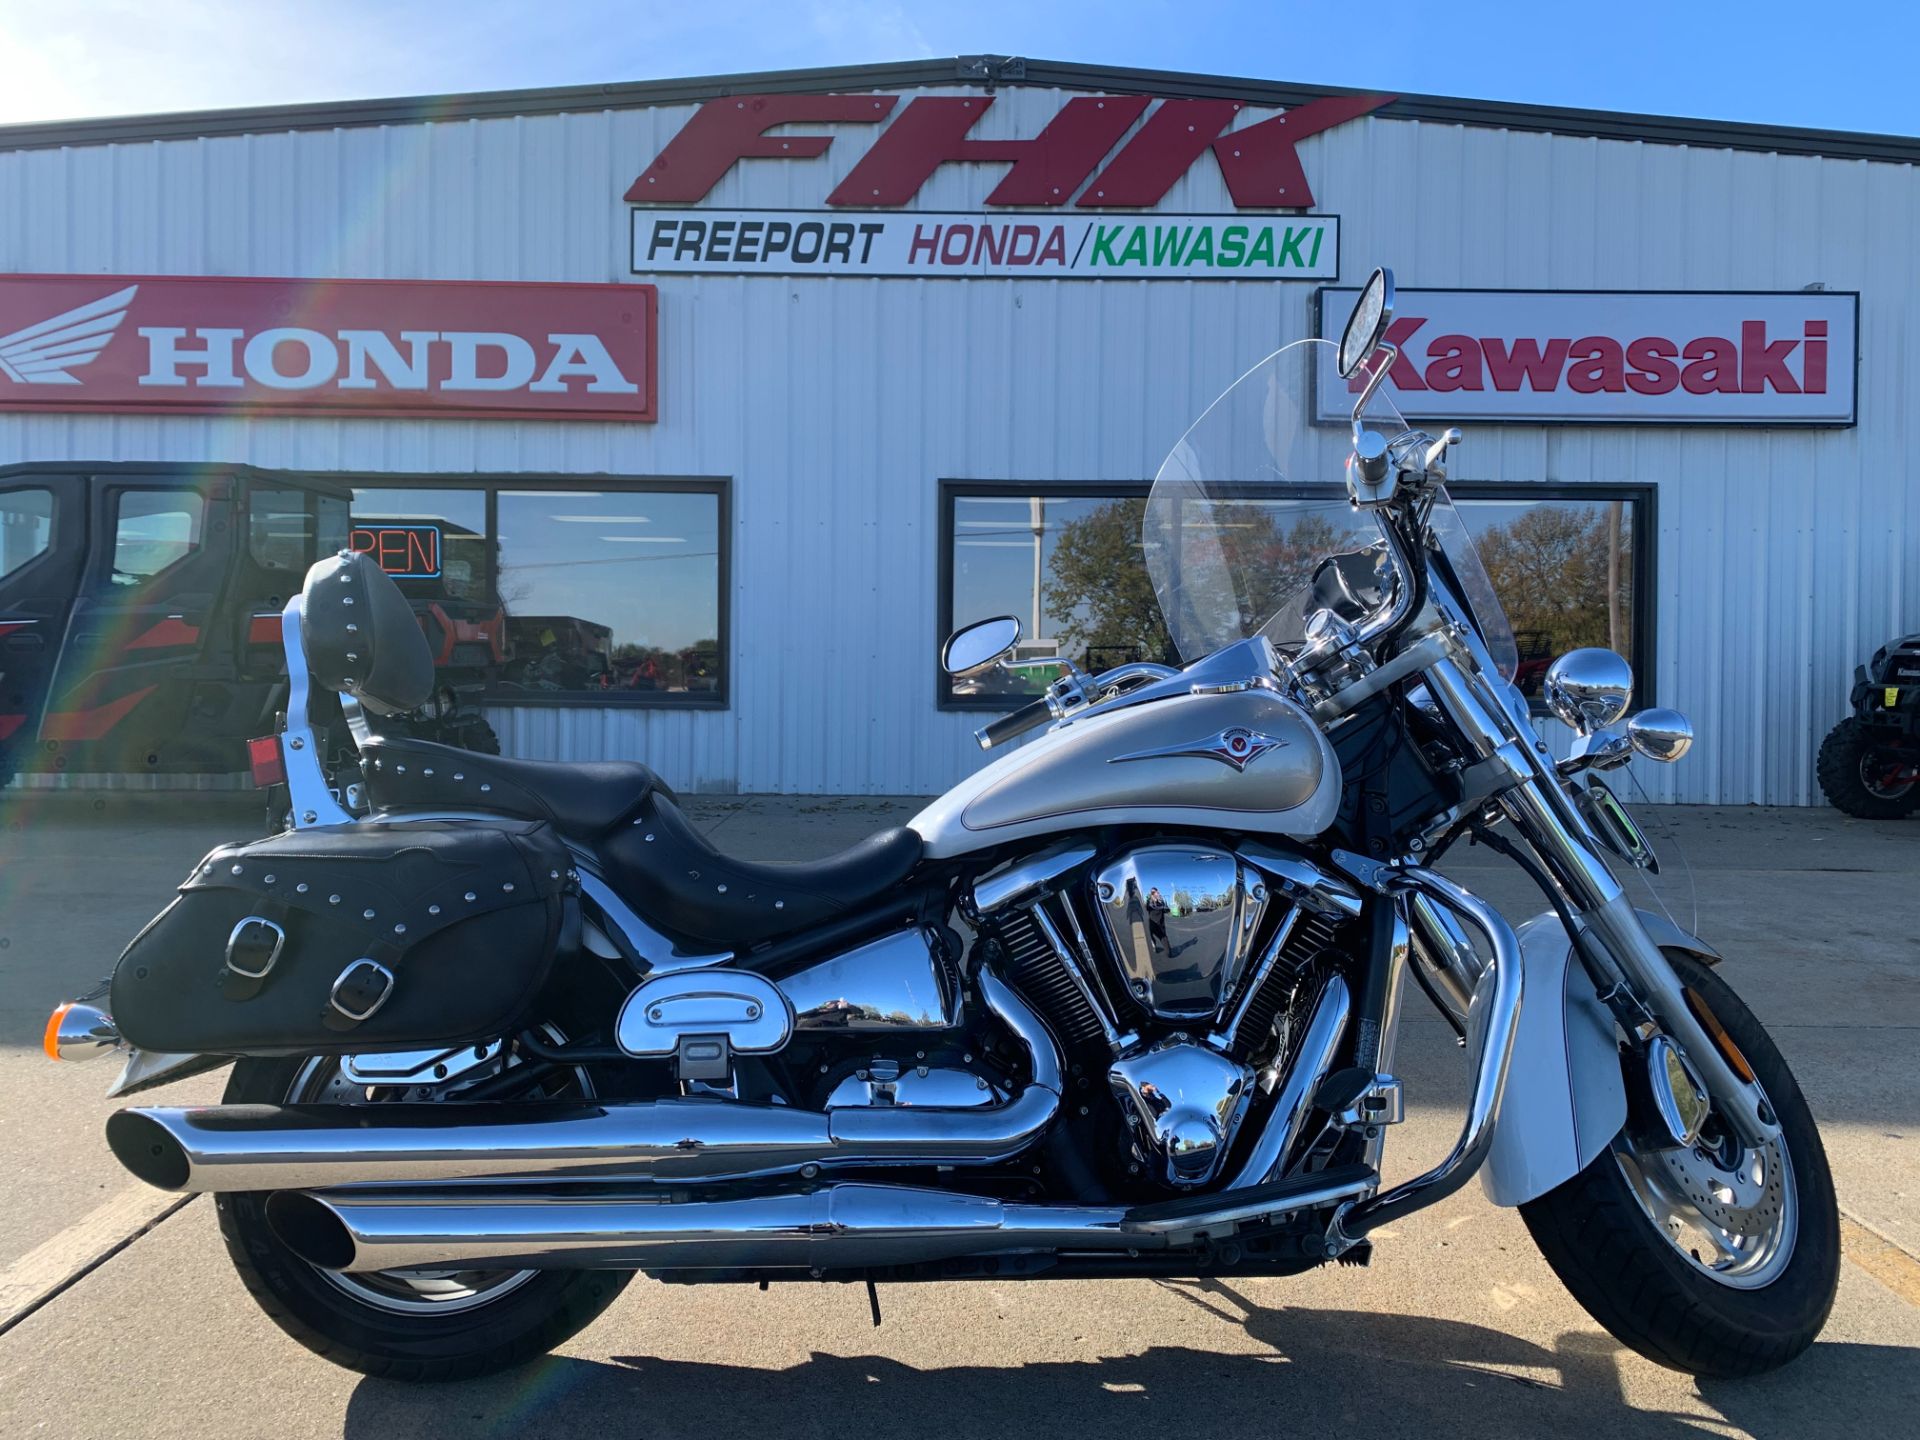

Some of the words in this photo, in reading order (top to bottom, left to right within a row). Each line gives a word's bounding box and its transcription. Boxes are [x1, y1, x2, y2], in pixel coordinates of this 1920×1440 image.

[624, 95, 1398, 208] FHK
[648, 221, 884, 264] FREEPORT
[138, 327, 638, 393] HONDA
[350, 529, 435, 573] PEN
